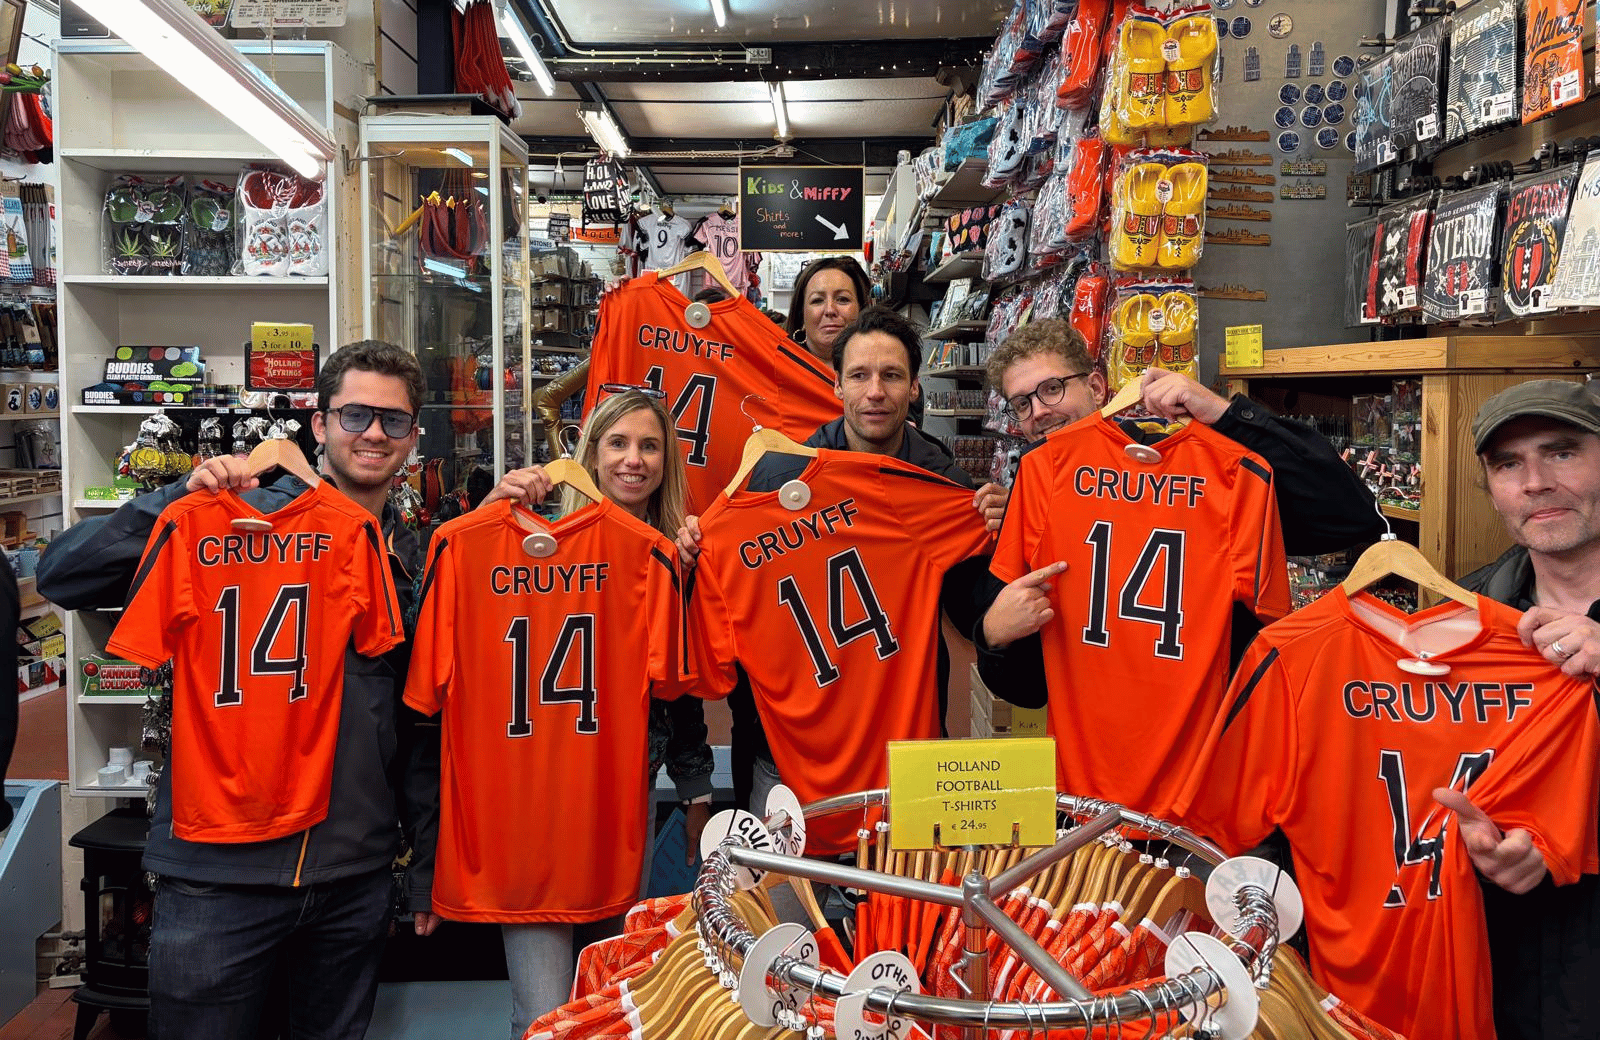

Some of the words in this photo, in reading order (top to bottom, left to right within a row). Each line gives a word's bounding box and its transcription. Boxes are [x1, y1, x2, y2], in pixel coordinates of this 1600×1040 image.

[790, 179, 803, 200] &
[656, 229, 668, 249] 9
[713, 234, 739, 258] 10
[273, 328, 289, 337] 3.95
[638, 323, 735, 362] CRUYFF
[261, 340, 268, 349] 3
[107, 362, 155, 374] BUDDIES
[84, 391, 114, 399] BUDDIES
[1074, 465, 1207, 508] CRUYFF
[738, 497, 859, 570] CRUYFF
[197, 532, 333, 568] CRUYFF
[490, 562, 610, 596] CRUYFF
[1081, 519, 1187, 662] 14
[777, 546, 900, 688] 14
[213, 582, 311, 708] 14
[100, 669, 141, 680] CANNABI
[503, 613, 600, 738] 14
[1343, 680, 1535, 723] CRUYFF
[937, 760, 1001, 772] HOLLAND
[936, 780, 1003, 792] FOOTBALL
[942, 800, 998, 812] T-SHIRTS
[960, 819, 988, 830] 24.95
